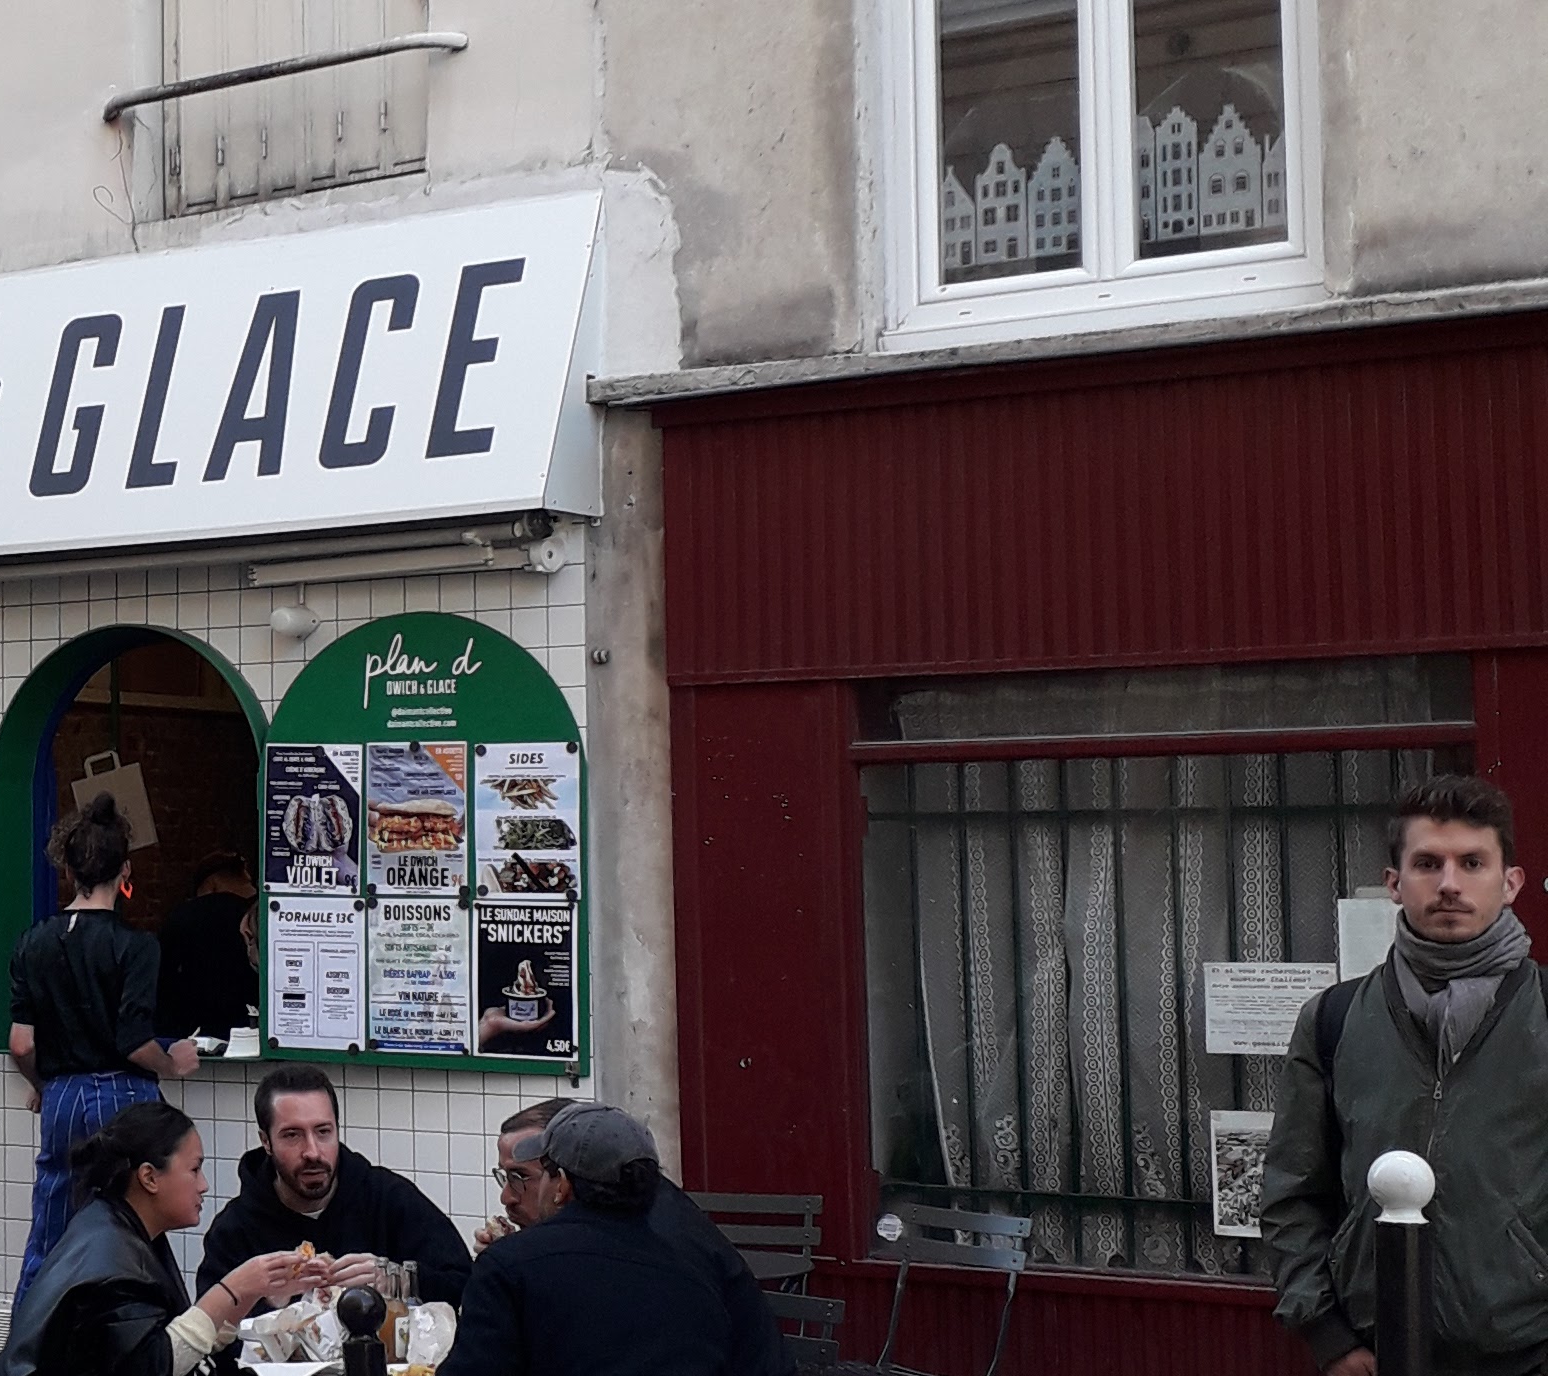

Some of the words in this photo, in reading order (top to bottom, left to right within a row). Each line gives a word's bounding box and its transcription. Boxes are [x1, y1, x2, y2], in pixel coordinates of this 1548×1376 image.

[27, 256, 527, 498] GLACE
[363, 633, 438, 709] plan
[452, 637, 483, 676] d
[386, 679, 418, 696] DWICH
[426, 679, 457, 694] GLACE
[508, 752, 545, 765] SIDES
[294, 855, 305, 866] LE
[305, 855, 333, 867] DWICH
[399, 855, 409, 866] LE
[410, 855, 438, 867] DWICH
[286, 866, 339, 887] VIOLET
[386, 867, 450, 887] ORANGE
[278, 911, 333, 924] FORMULE
[383, 904, 451, 921] BOISSONS
[480, 907, 492, 921] LE
[494, 908, 532, 922] SUNDAE
[533, 909, 571, 923] MAISON
